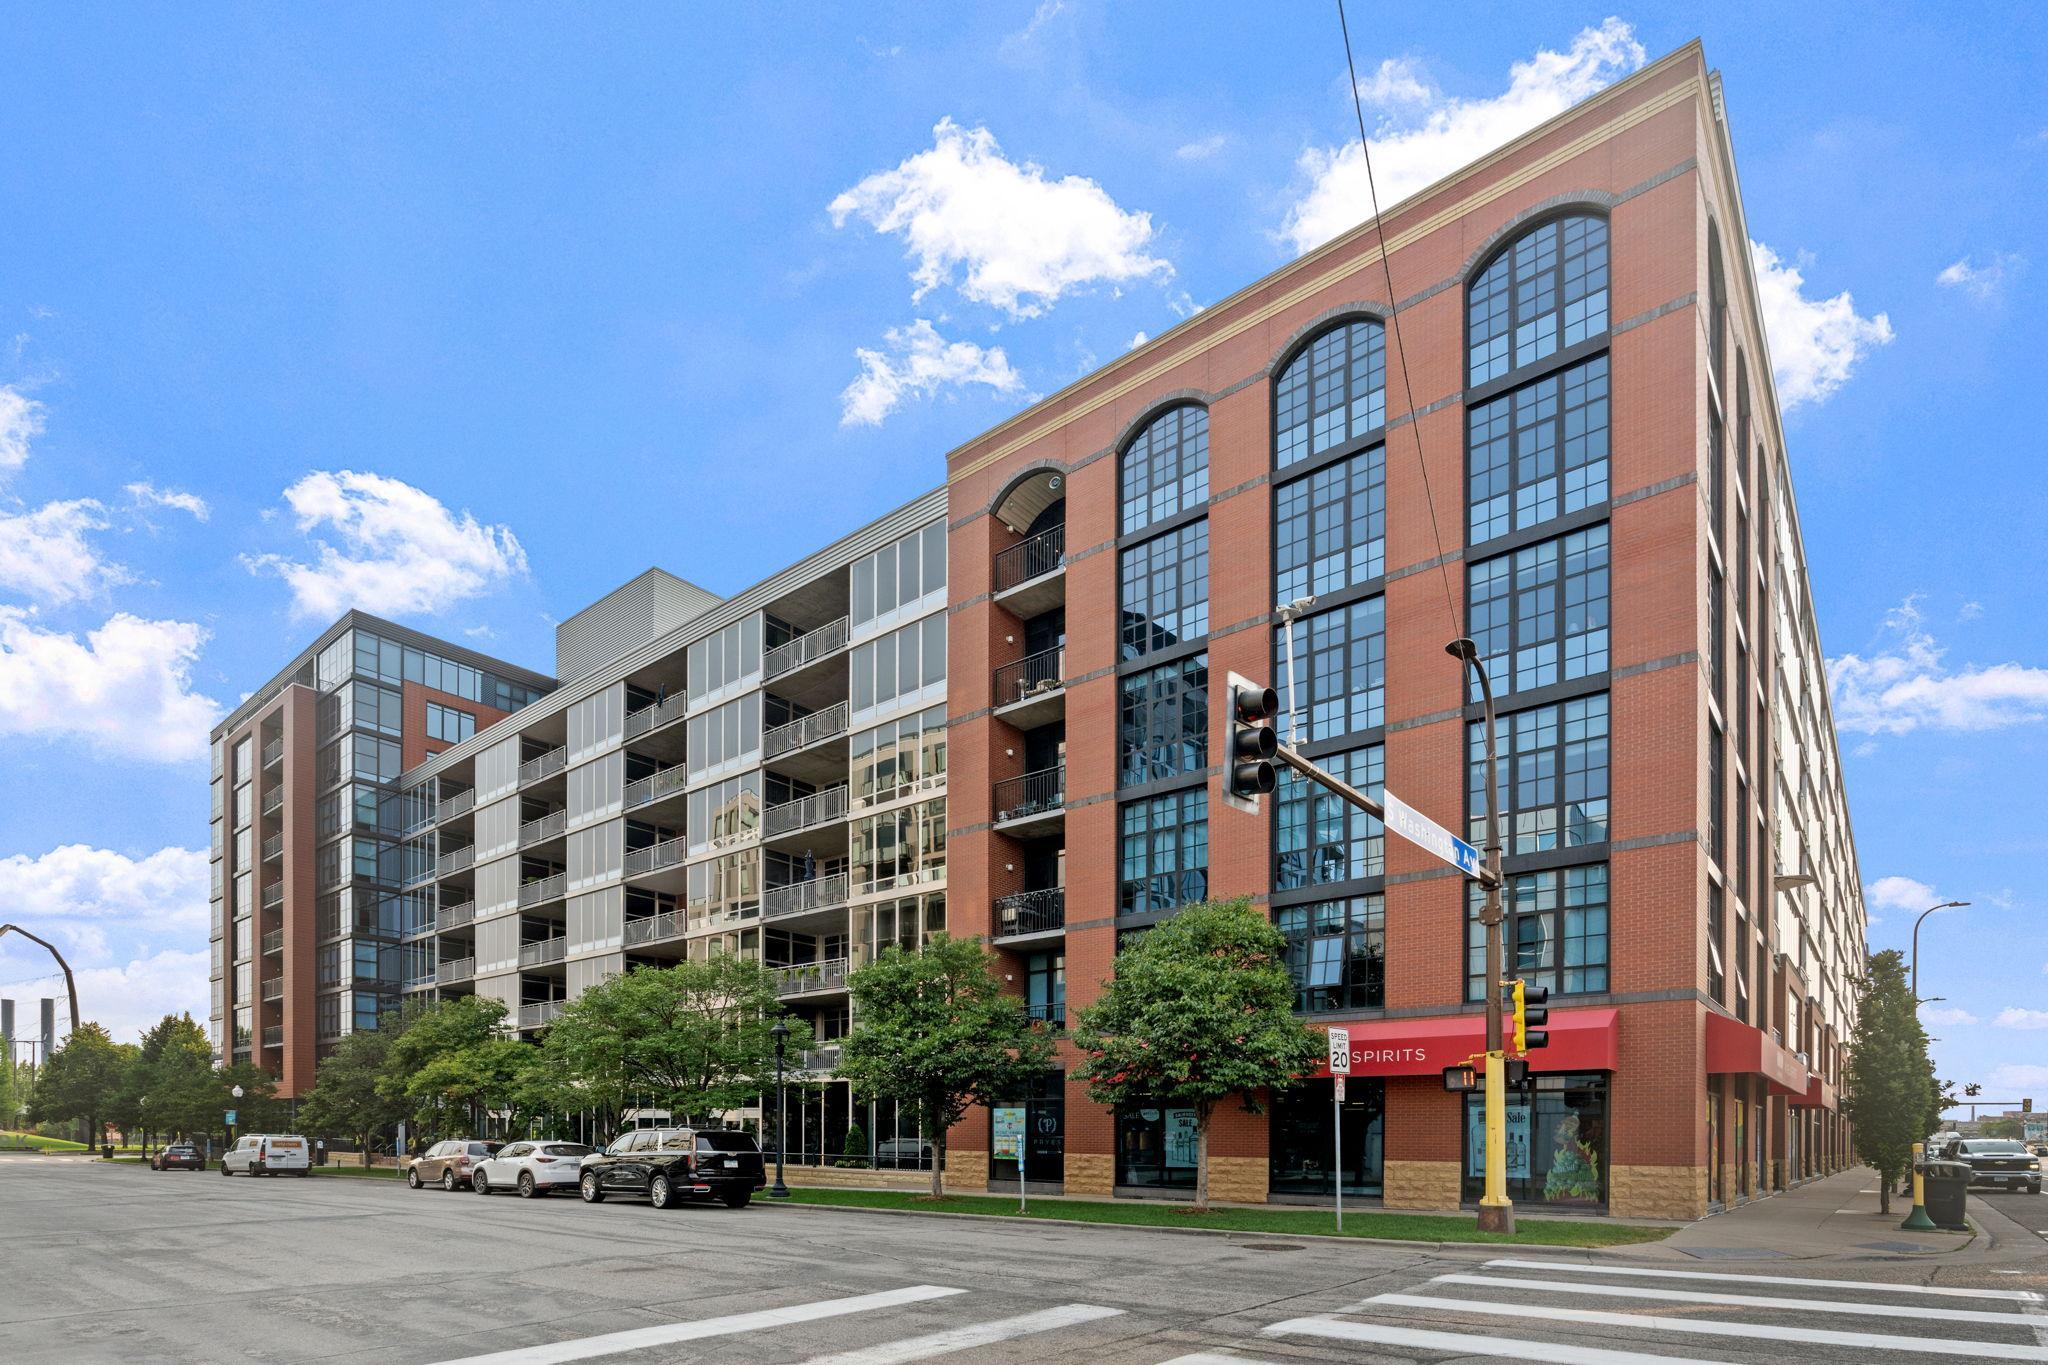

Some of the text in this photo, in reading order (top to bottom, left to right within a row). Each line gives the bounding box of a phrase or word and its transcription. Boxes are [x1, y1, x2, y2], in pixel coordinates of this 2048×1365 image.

[1398, 808, 1460, 861] Washington
[1331, 1032, 1348, 1041] SPEED
[1332, 1042, 1346, 1050] LIMIT
[1332, 1051, 1348, 1068] 20
[1352, 1048, 1426, 1064] SPIRITS
[1463, 1071, 1475, 1086] 11
[1178, 1119, 1192, 1128] SALE
[1506, 1111, 1526, 1123] Sale
